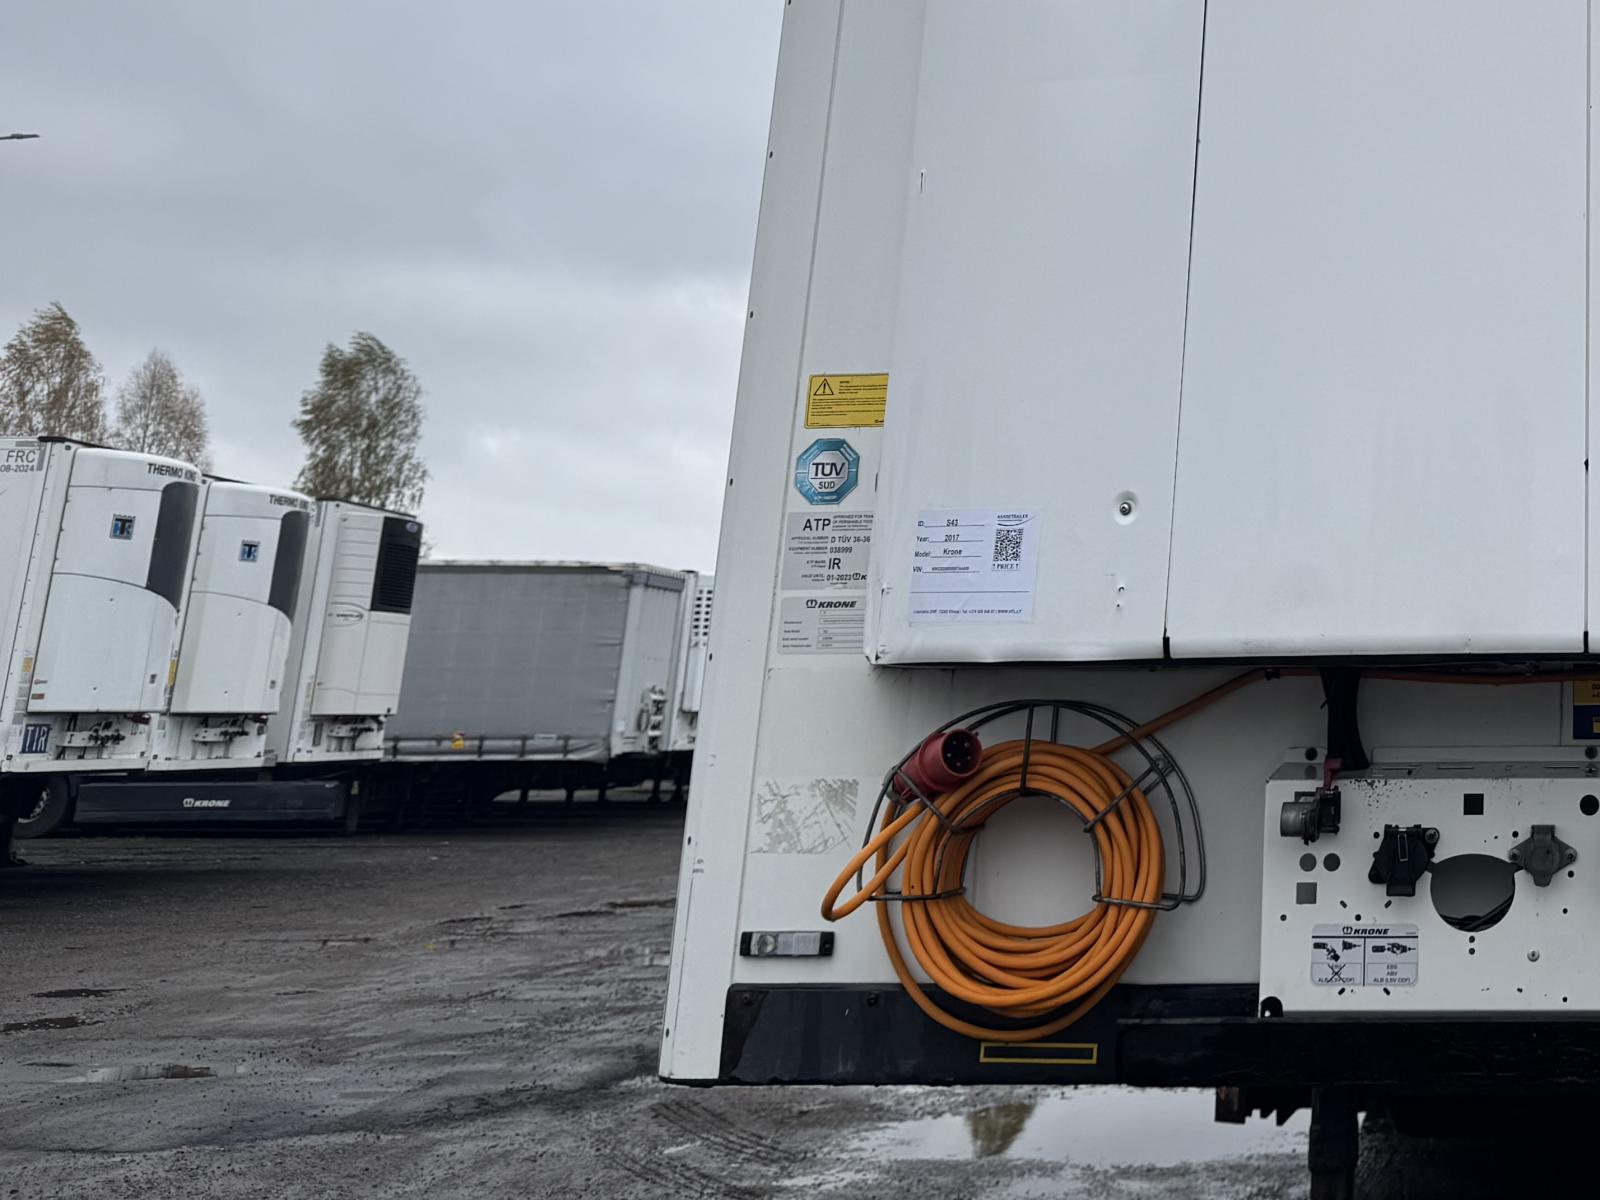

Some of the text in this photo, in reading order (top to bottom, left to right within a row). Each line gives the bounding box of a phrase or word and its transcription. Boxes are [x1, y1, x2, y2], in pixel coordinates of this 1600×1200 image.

[6, 450, 36, 463] FRC
[147, 463, 183, 479] THERMO
[812, 462, 846, 477] TÜV
[803, 518, 831, 532] ATP
[828, 557, 841, 570] IR
[818, 600, 857, 609] KRONE
[25, 726, 49, 752] TIR
[193, 799, 231, 808] KRONE
